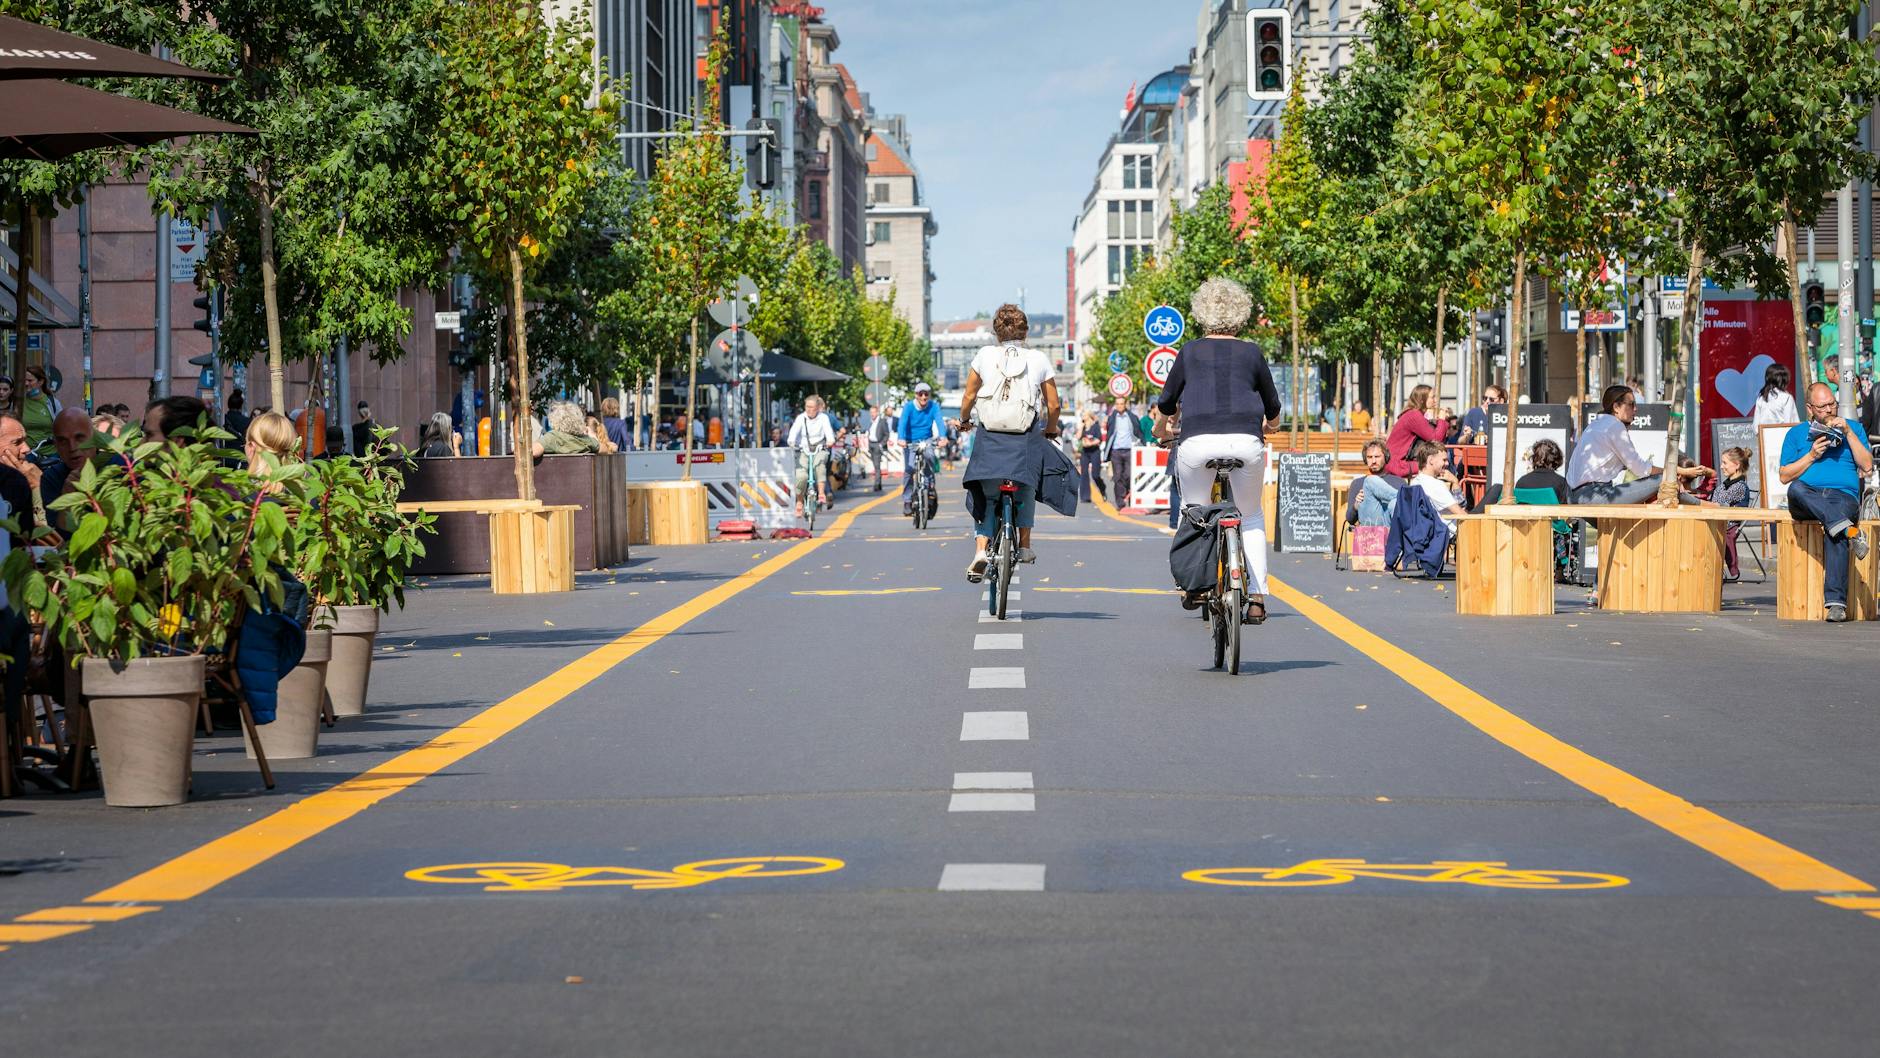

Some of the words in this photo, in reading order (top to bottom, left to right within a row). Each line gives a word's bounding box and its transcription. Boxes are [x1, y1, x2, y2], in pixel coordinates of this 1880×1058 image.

[1713, 320, 1747, 328] Minuten
[1492, 412, 1552, 427] Booncept
[1280, 453, 1327, 465] ChariTea
